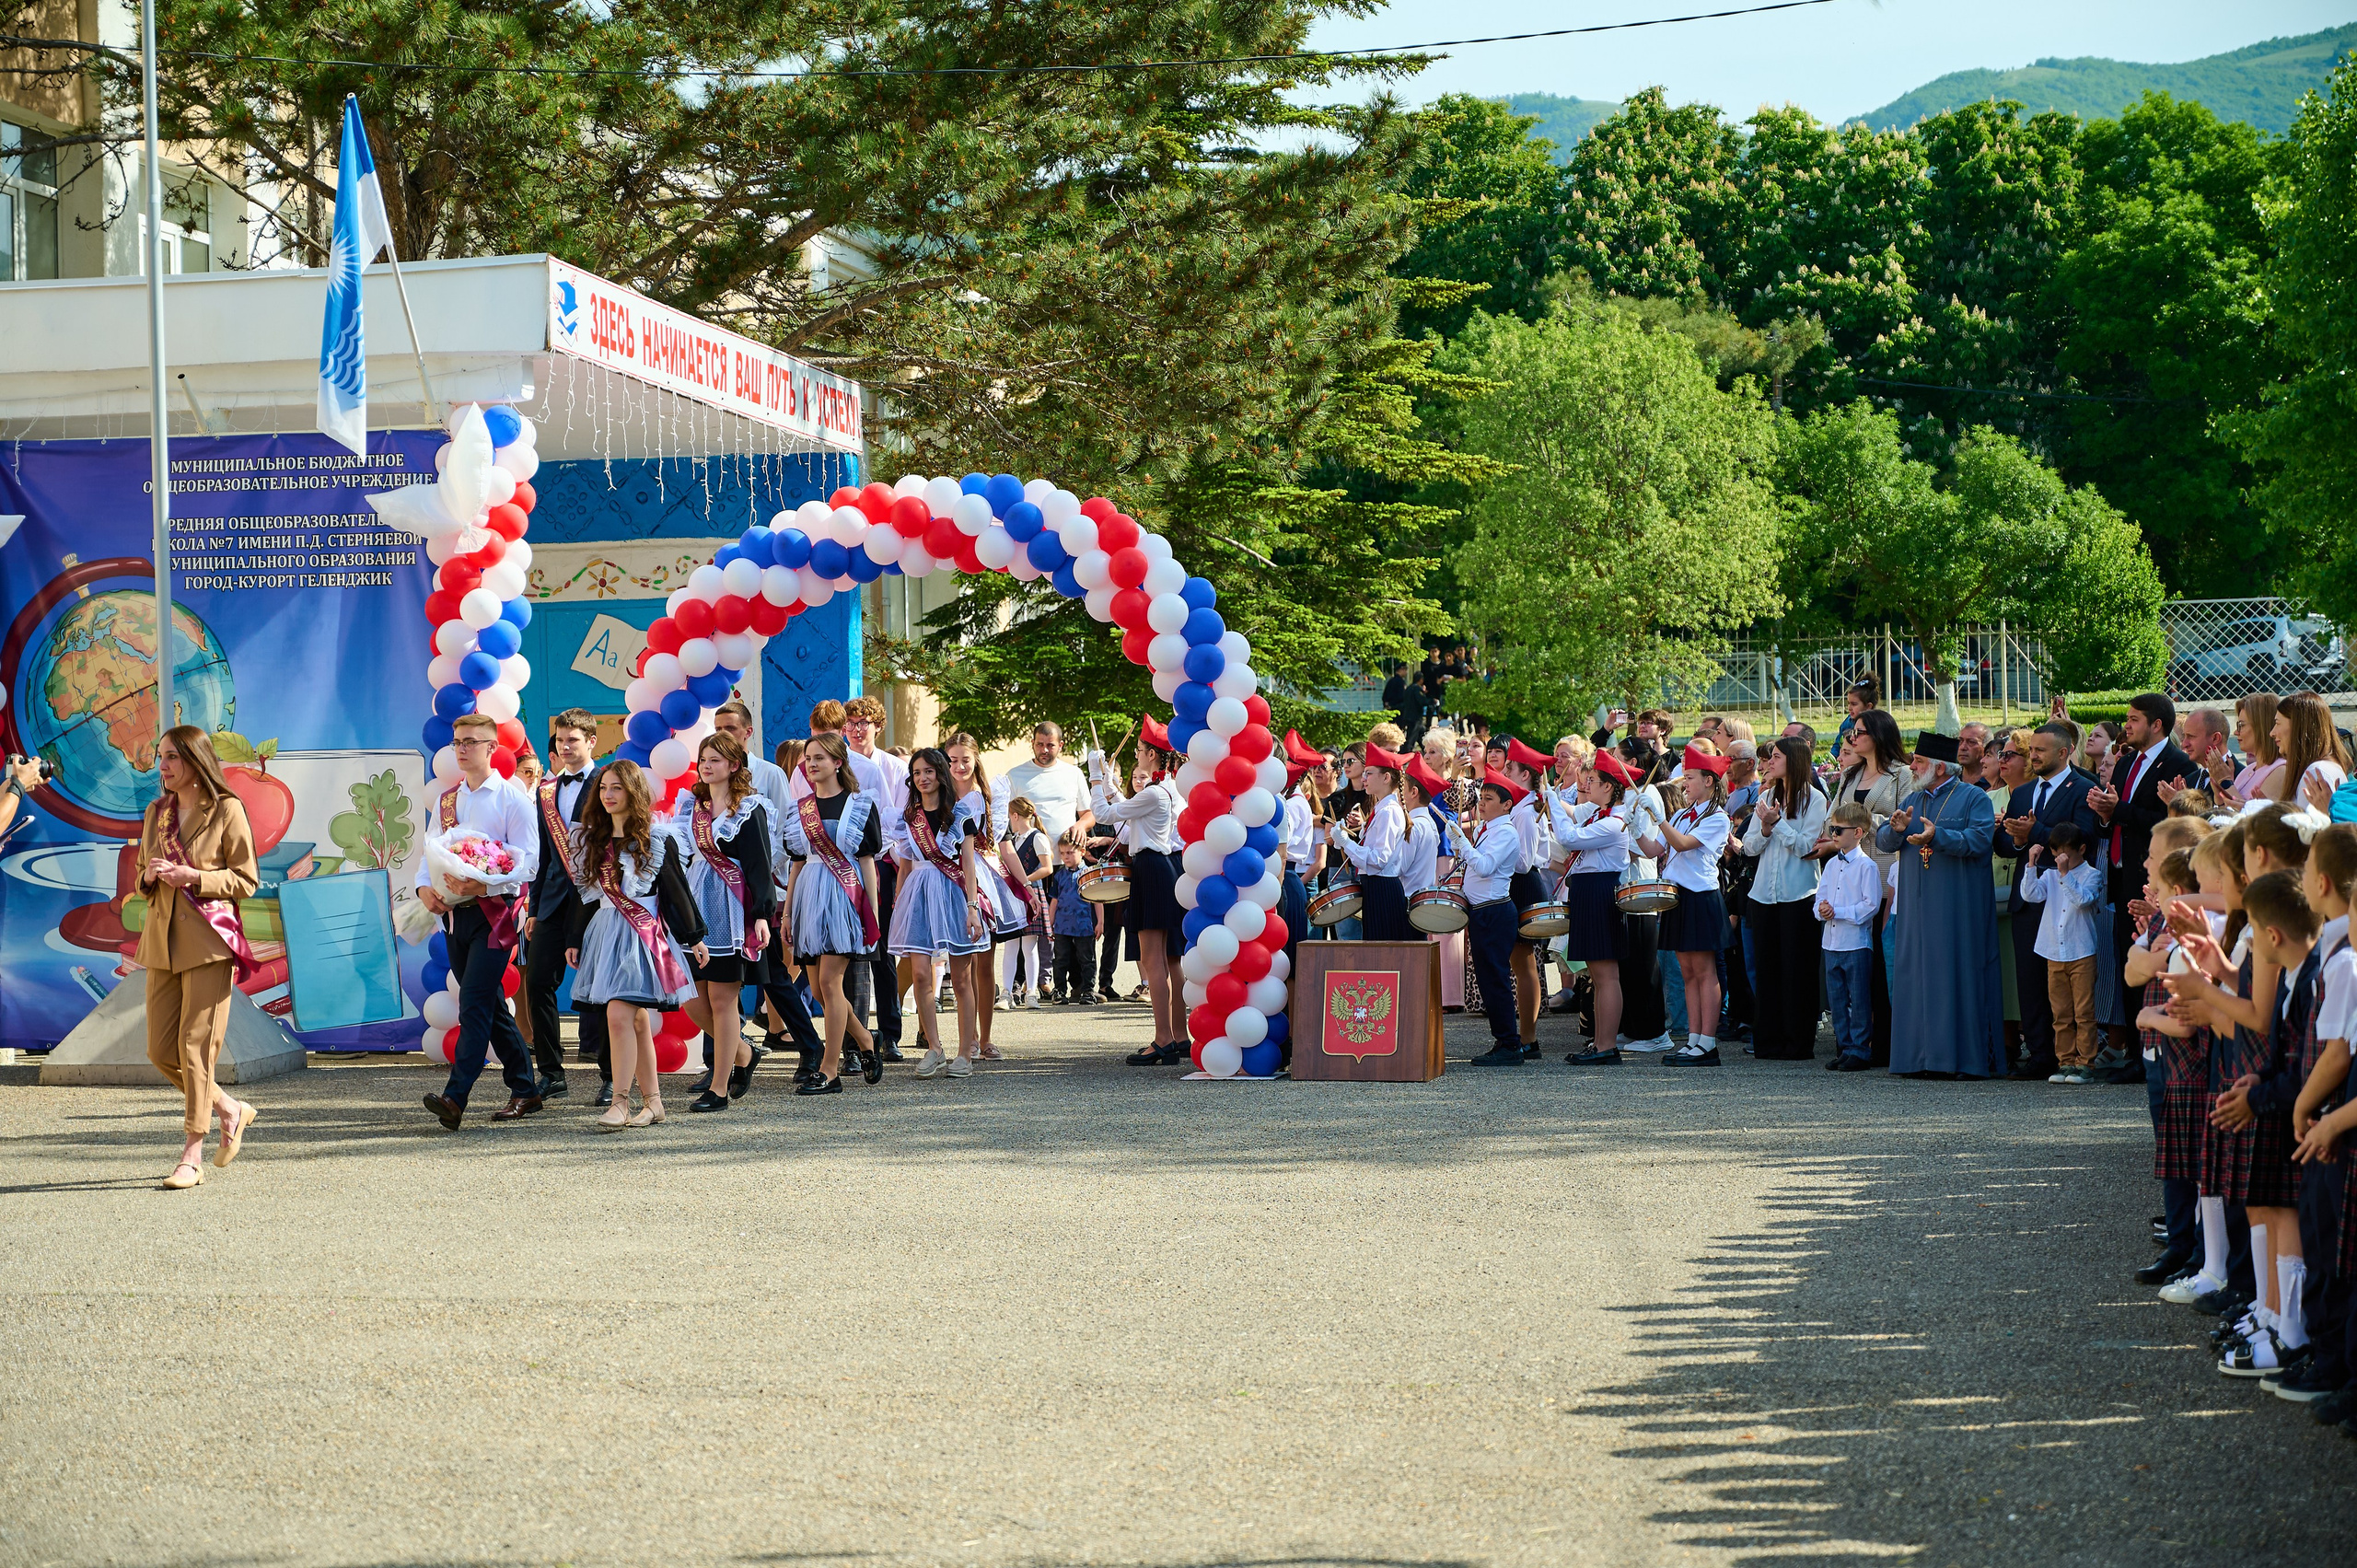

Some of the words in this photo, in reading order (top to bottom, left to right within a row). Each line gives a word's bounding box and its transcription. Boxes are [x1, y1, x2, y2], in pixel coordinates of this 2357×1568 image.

[589, 292, 634, 360] ЗДЕСЬ
[642, 316, 727, 393] НАЧИНАЕТСЯ
[736, 350, 762, 405] ВАШ
[766, 363, 796, 416] ПУТЬ
[803, 377, 809, 423] К
[816, 381, 861, 439] УСПЕХУ!
[171, 457, 306, 474] МУНИЦИПАЛЬНОЕ
[143, 475, 329, 495] ОЩЕОБРАЗОВАТЕЛЬНОЕ
[331, 473, 433, 490] УЧРЕЖДЕНИЕ
[168, 517, 225, 534] РЕДНЯЯ
[228, 513, 385, 532] ОБЩЕОБРАЗОВАТЕЛ
[151, 537, 206, 551] КОЛА
[209, 537, 234, 550] №7
[238, 535, 292, 550] ИМЕНИ
[295, 534, 324, 551] П.Д.
[169, 554, 306, 572] УНИЦИПАЛЬНОГО
[308, 552, 416, 567] ОБРАЗОВАНИЯ
[184, 575, 296, 591] ГОРОД-КУРОРТ
[298, 572, 393, 588] ГЕЛЕНДЖИК
